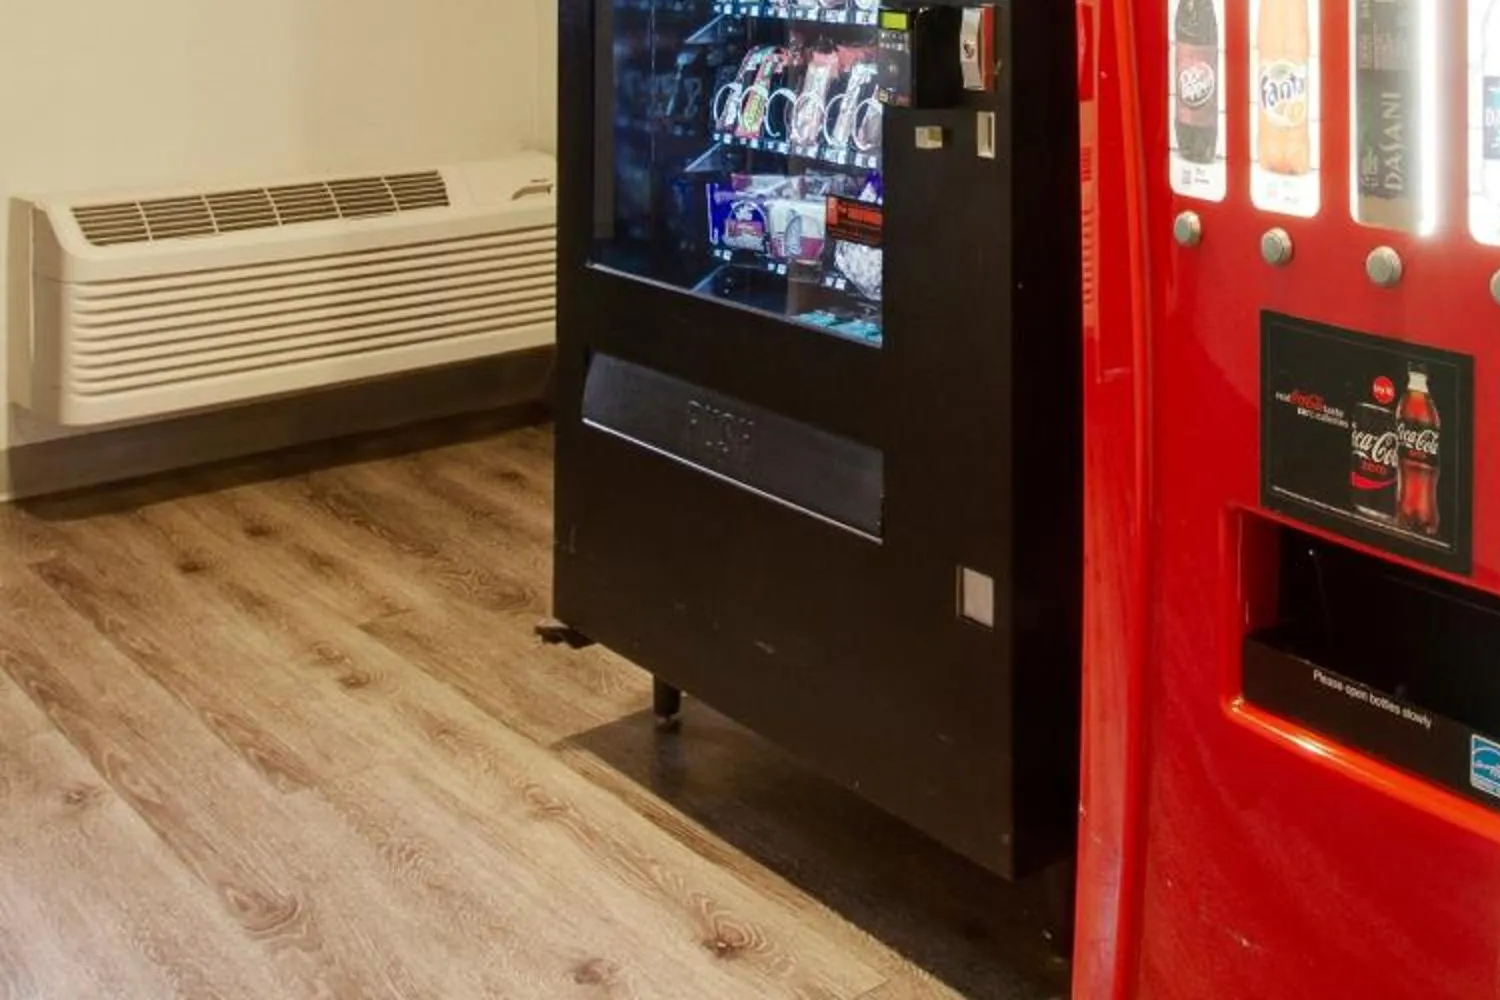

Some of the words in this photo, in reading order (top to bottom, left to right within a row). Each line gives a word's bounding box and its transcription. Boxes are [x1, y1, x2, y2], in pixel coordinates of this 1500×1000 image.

[1379, 91, 1403, 191] DASANI
[1313, 668, 1343, 691] Please
[1345, 685, 1369, 702] open
[1369, 691, 1401, 716] bottles
[1402, 708, 1433, 730] slowly
